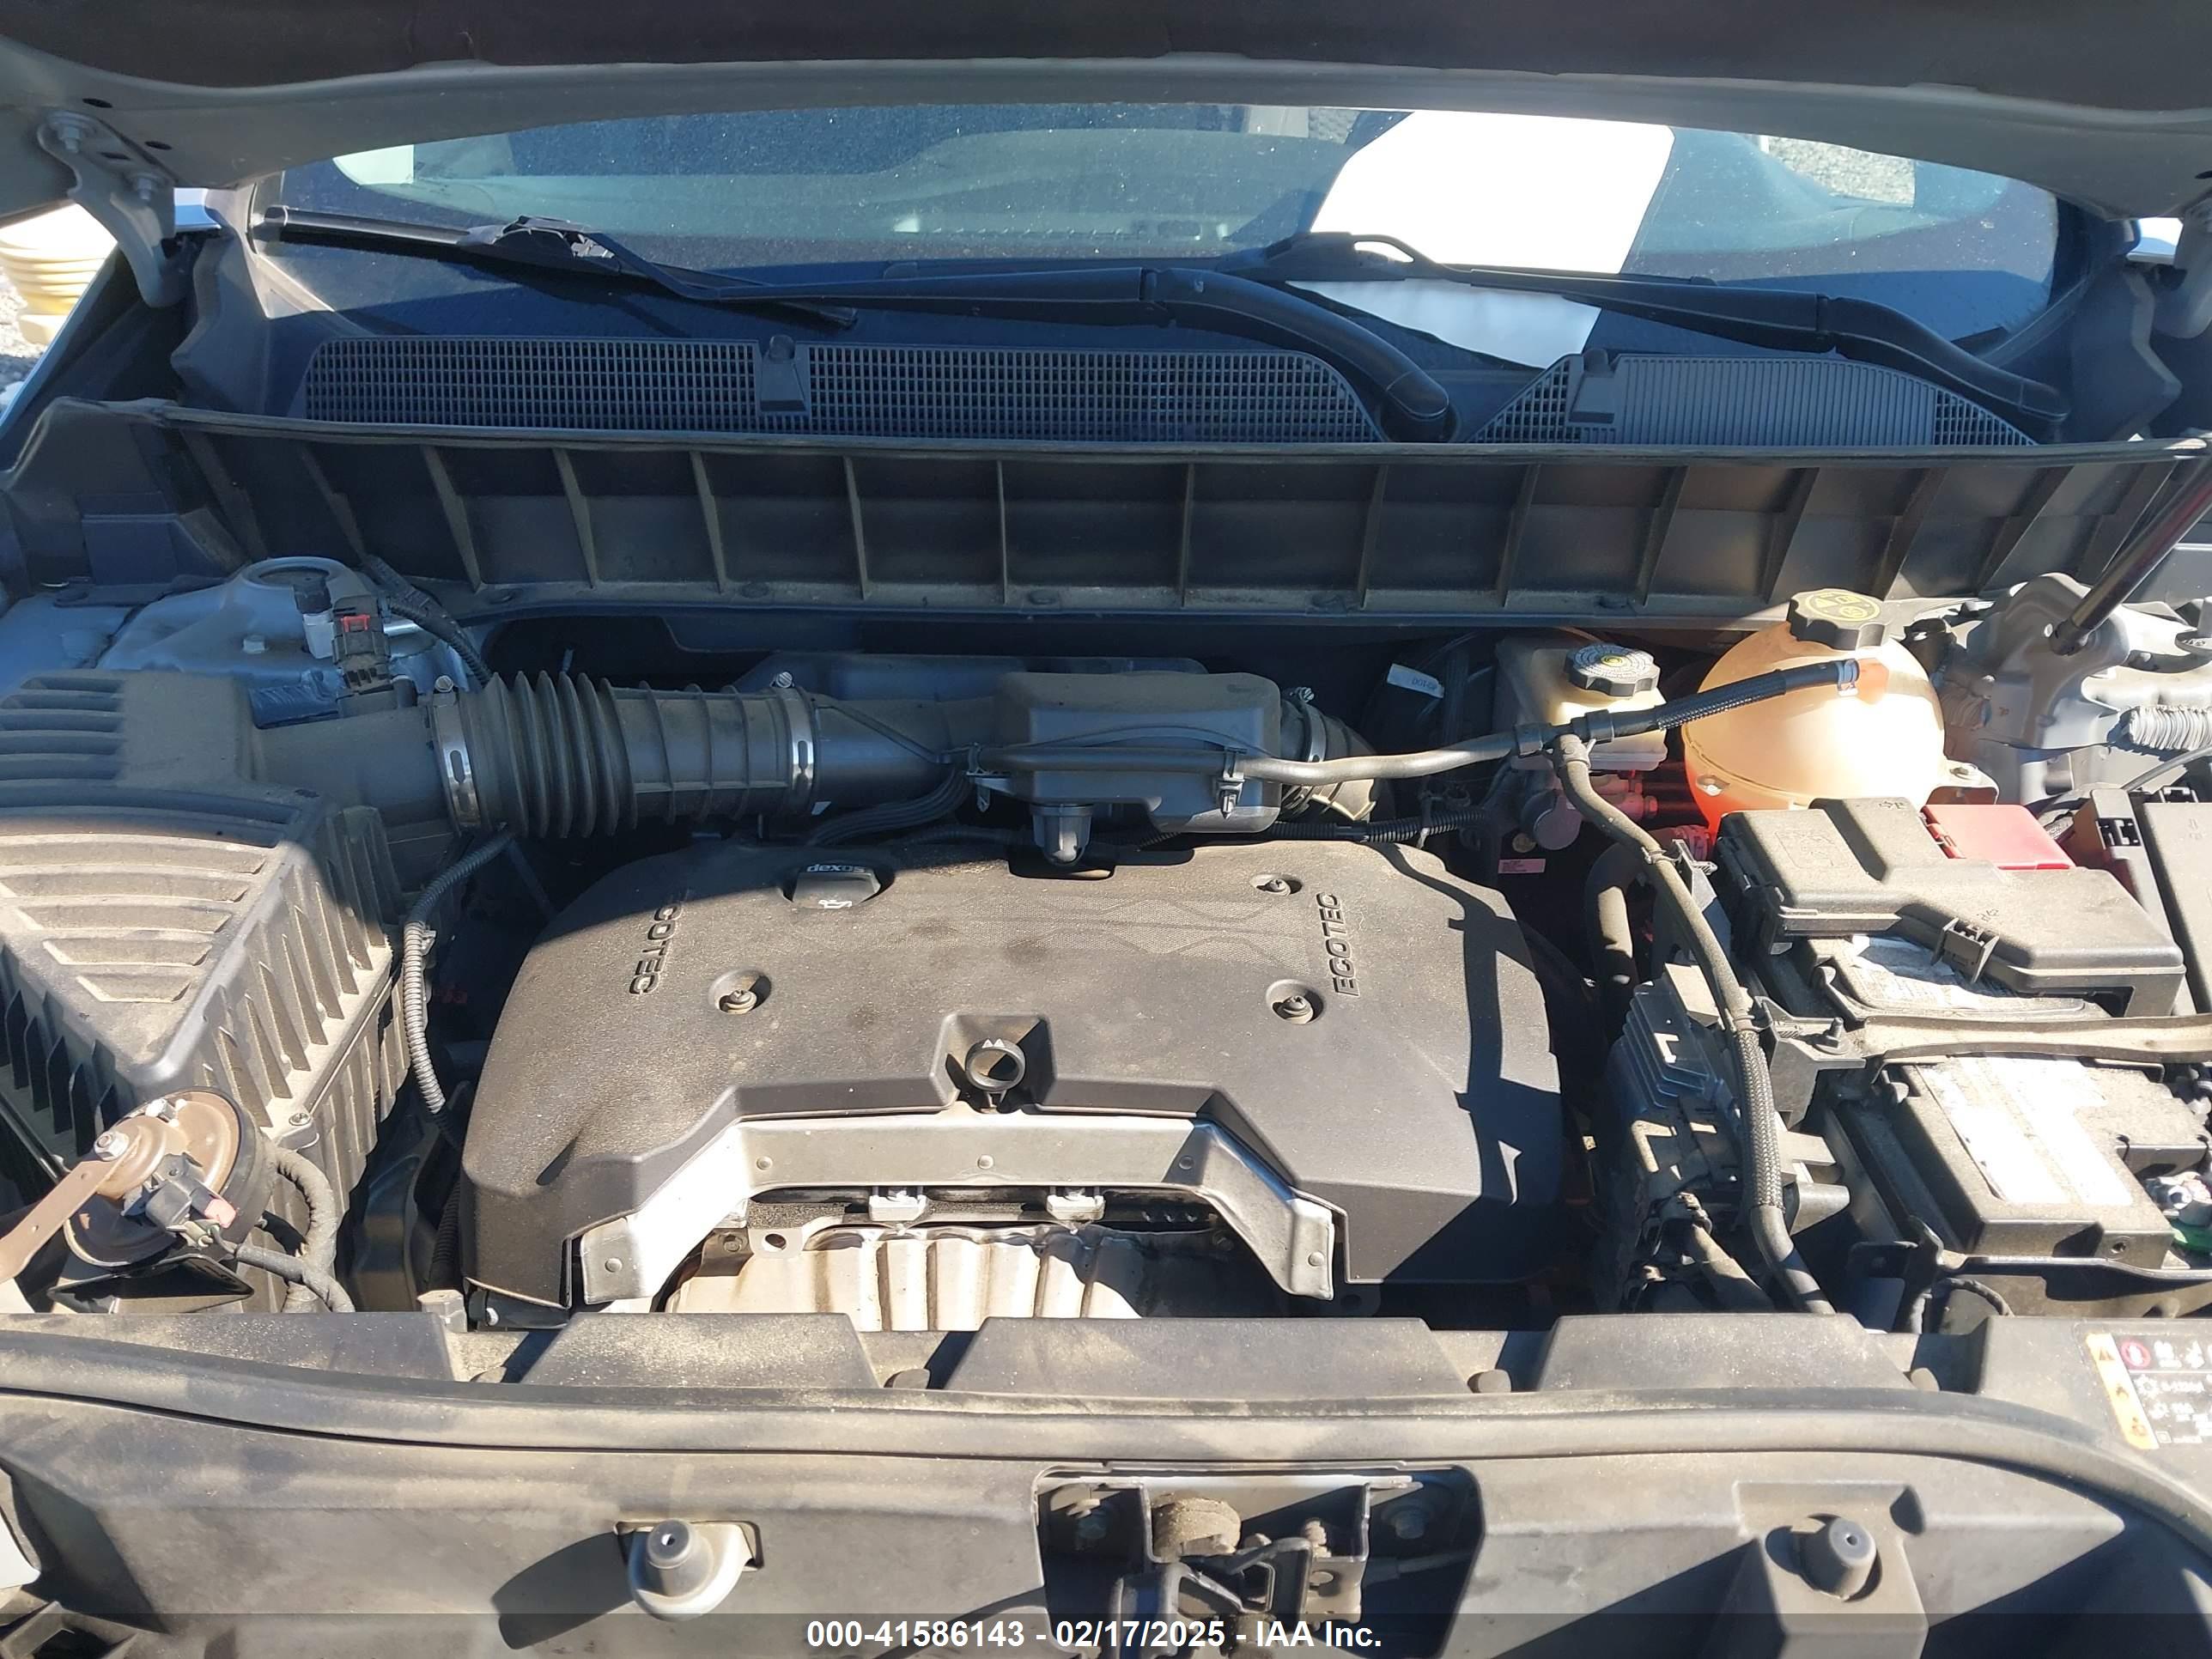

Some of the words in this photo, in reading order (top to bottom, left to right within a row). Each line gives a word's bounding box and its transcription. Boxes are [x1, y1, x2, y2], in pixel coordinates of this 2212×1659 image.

[806, 864, 866, 873] dexos
[628, 890, 690, 994] COTEC
[1316, 892, 1360, 997] ECOTEC
